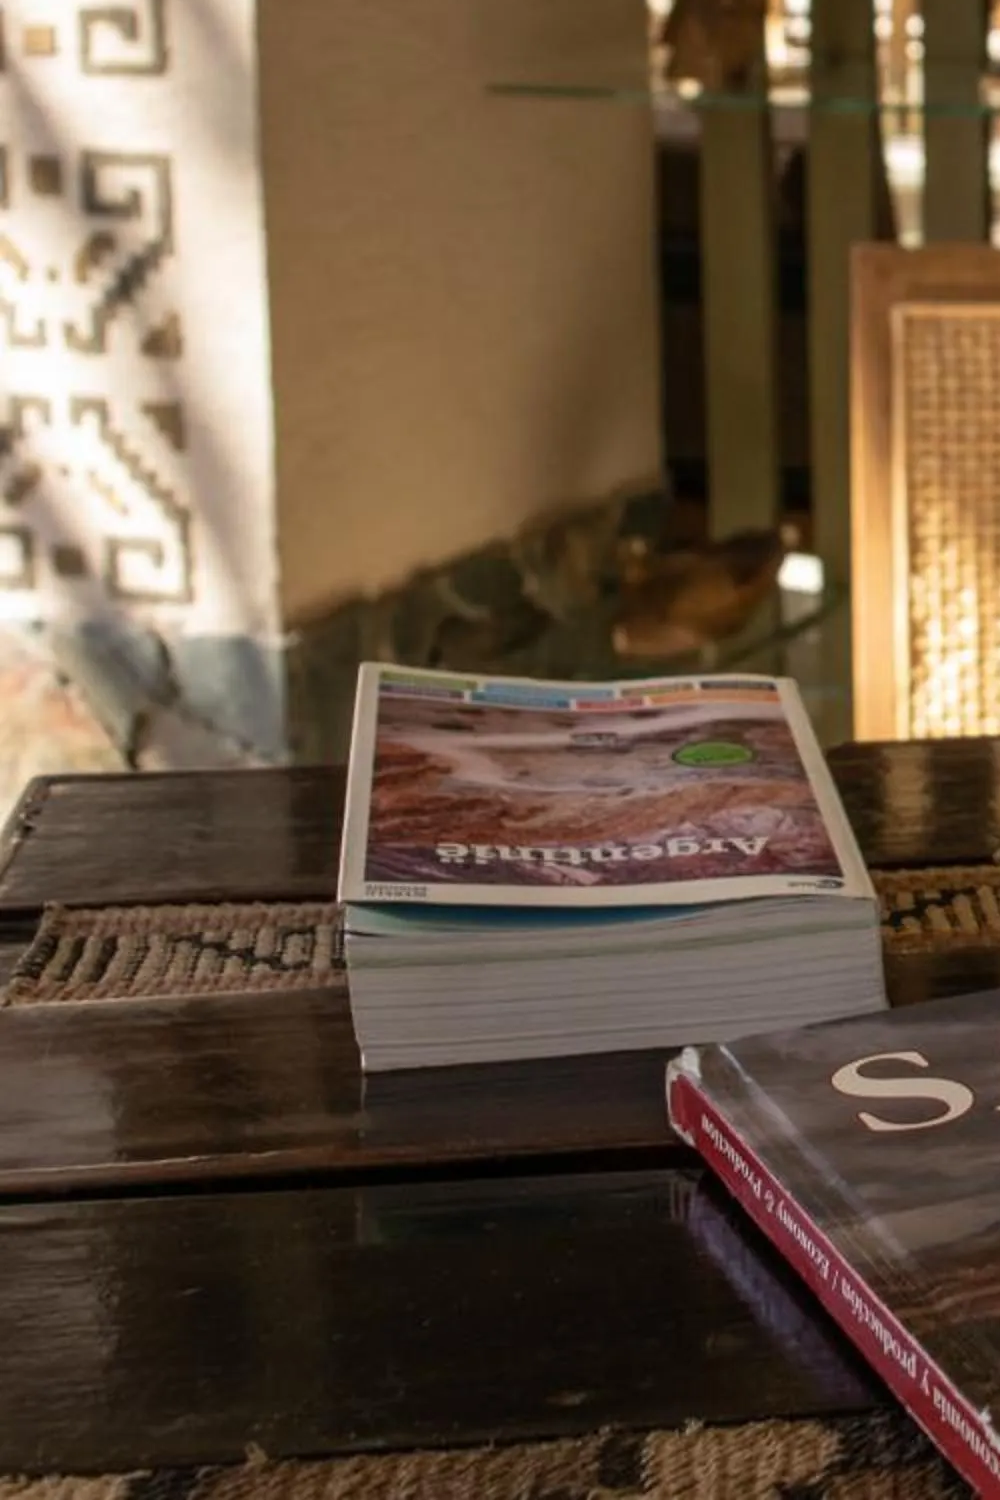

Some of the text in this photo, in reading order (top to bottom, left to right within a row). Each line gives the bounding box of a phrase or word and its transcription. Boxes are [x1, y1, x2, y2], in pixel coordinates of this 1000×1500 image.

[434, 835, 770, 867] Argentinië
[701, 1113, 763, 1200] Production
[775, 1199, 830, 1281] Economy
